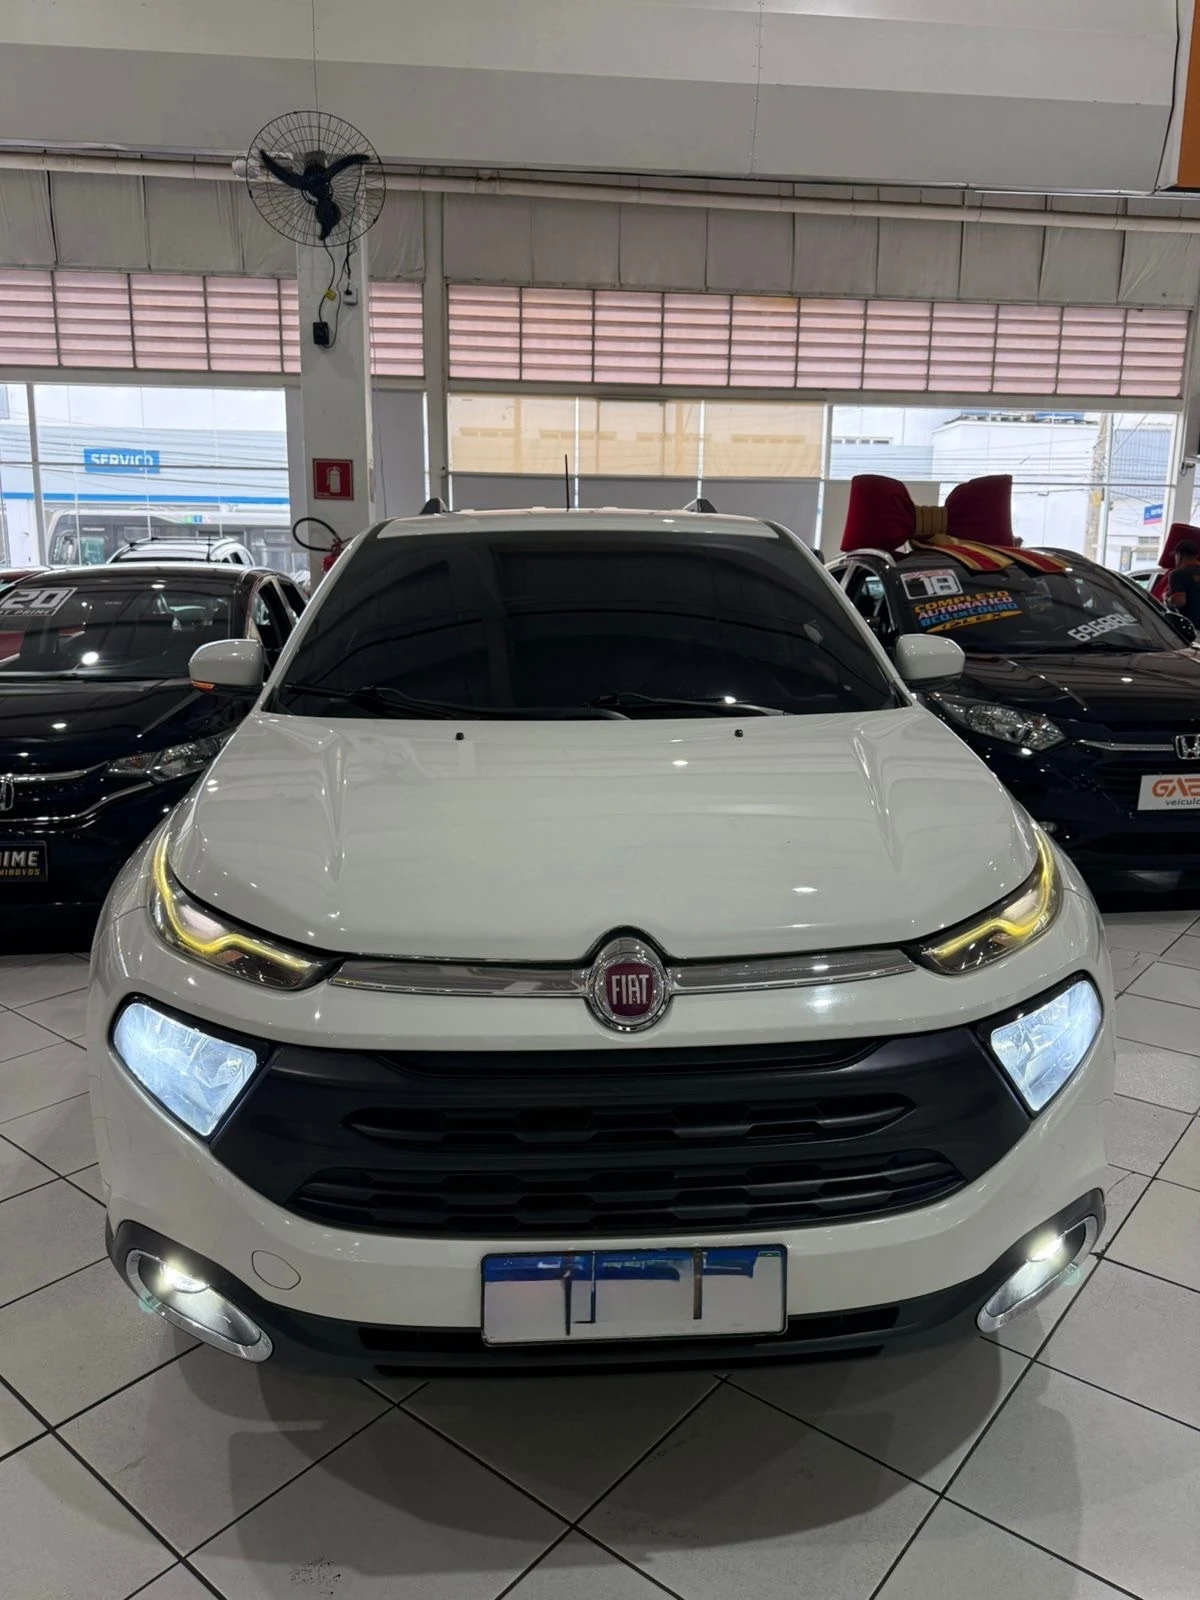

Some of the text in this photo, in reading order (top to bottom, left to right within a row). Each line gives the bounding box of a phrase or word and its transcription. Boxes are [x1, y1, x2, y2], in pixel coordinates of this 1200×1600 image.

[913, 590, 1010, 613] COMPLETO
[0, 851, 40, 867] IME
[611, 974, 649, 1005] FIAT
